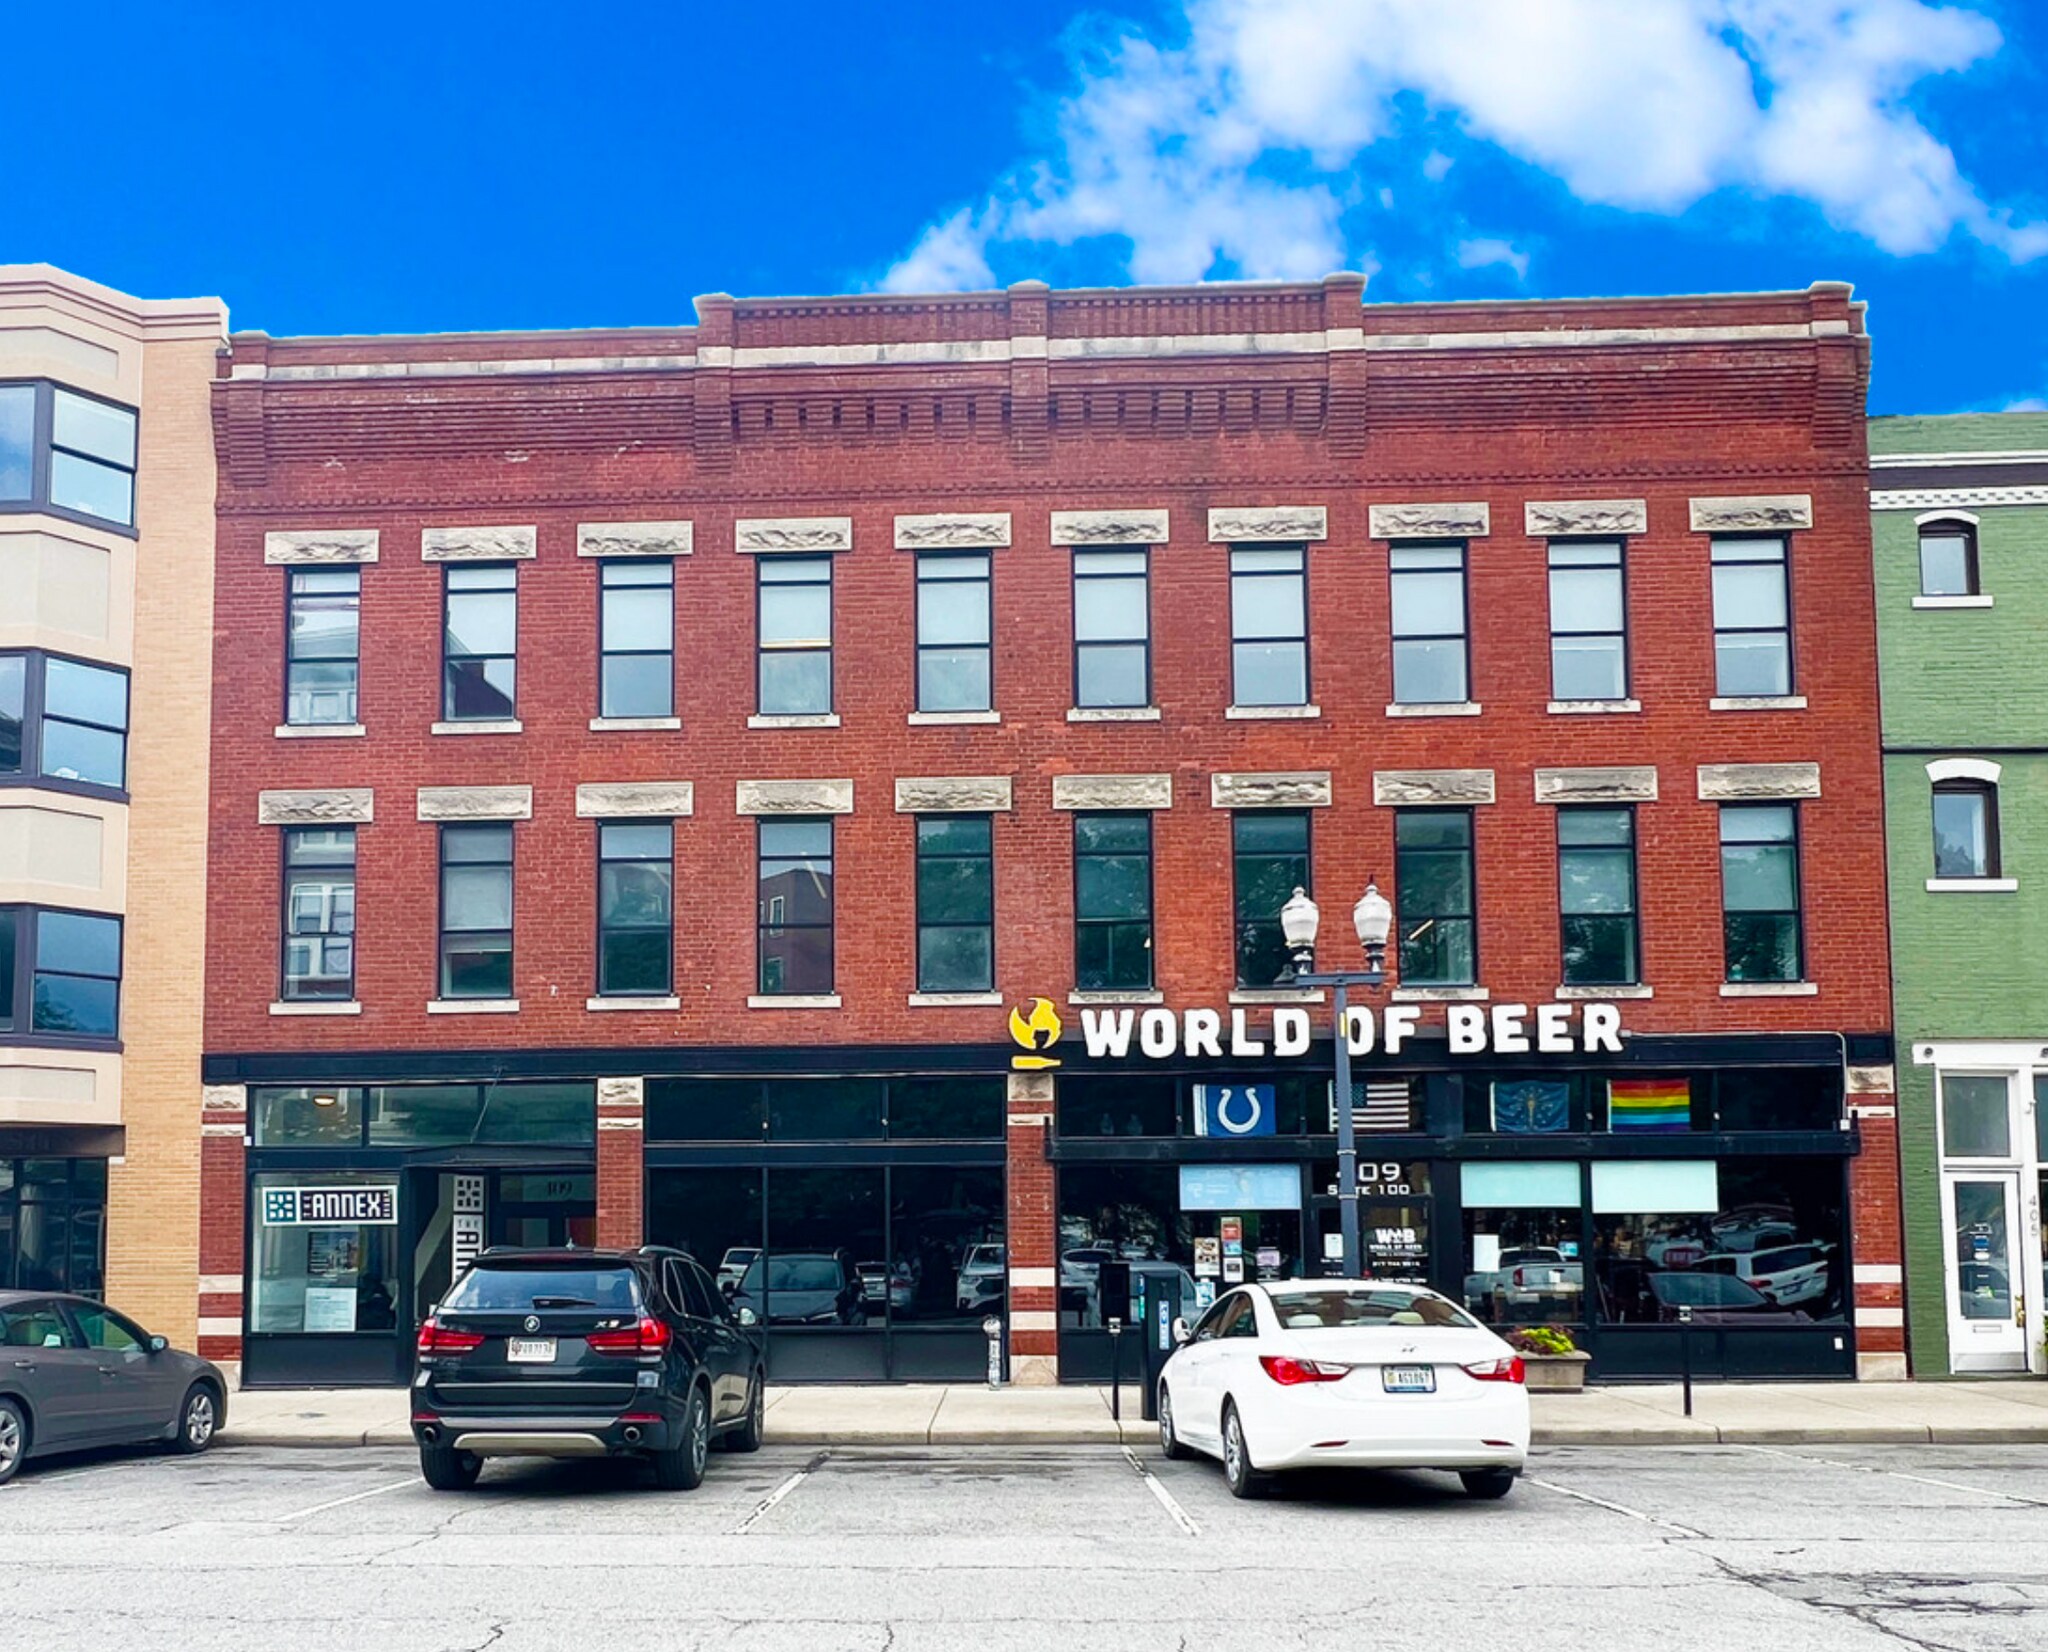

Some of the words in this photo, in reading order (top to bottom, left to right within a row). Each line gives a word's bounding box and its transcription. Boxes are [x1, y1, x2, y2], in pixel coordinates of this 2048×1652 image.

[1080, 1007, 1311, 1058] WORLD
[1346, 1005, 1421, 1055] OF
[1448, 1003, 1624, 1053] BEER
[1336, 1163, 1401, 1182] 09
[1327, 1184, 1371, 1196] STE
[1378, 1184, 1411, 1195] 100
[312, 1192, 381, 1218] ANNEX
